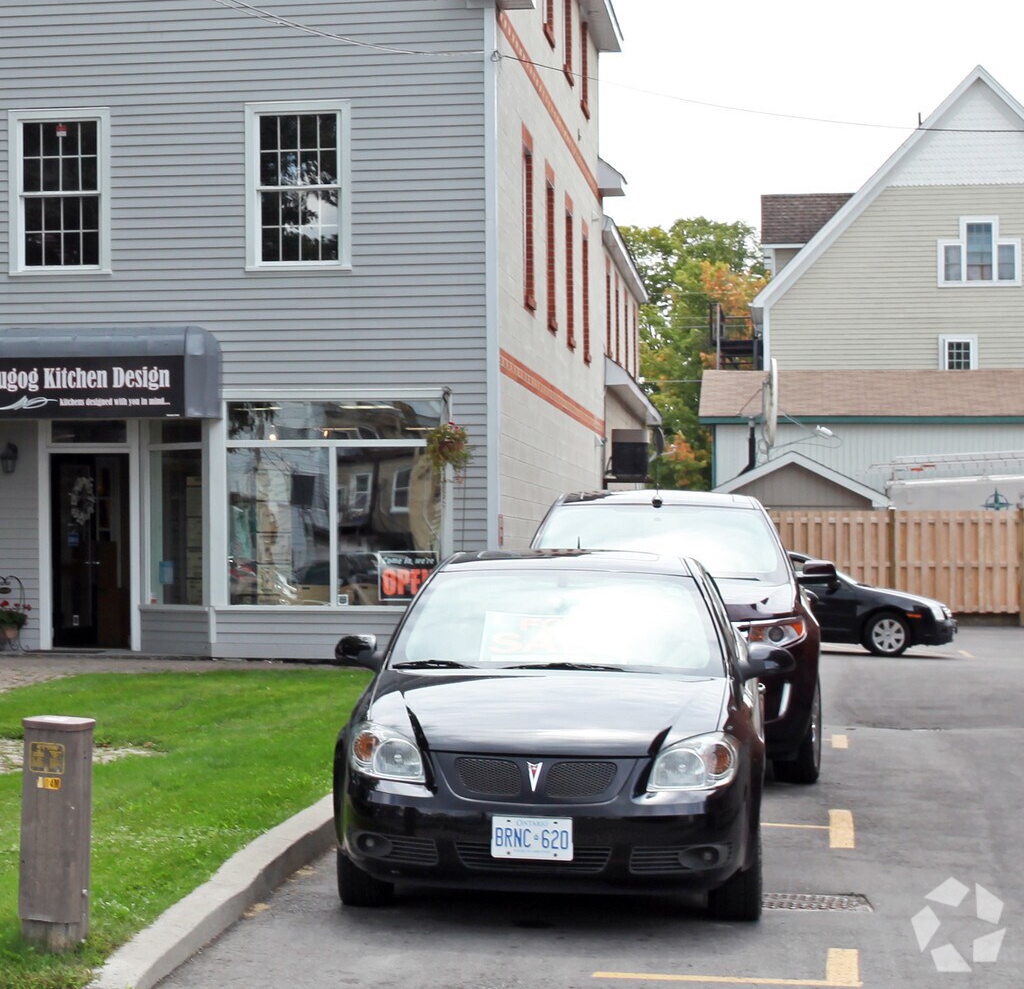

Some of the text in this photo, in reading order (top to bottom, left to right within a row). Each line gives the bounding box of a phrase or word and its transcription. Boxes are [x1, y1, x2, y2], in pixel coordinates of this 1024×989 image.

[43, 366, 108, 390] Kitchen
[112, 366, 171, 391] Design
[59, 398, 85, 407] kitchens
[85, 398, 113, 407] designed
[114, 398, 128, 406] with
[128, 398, 140, 407] you
[141, 397, 148, 405] in
[495, 827, 569, 850] BRNC 620
